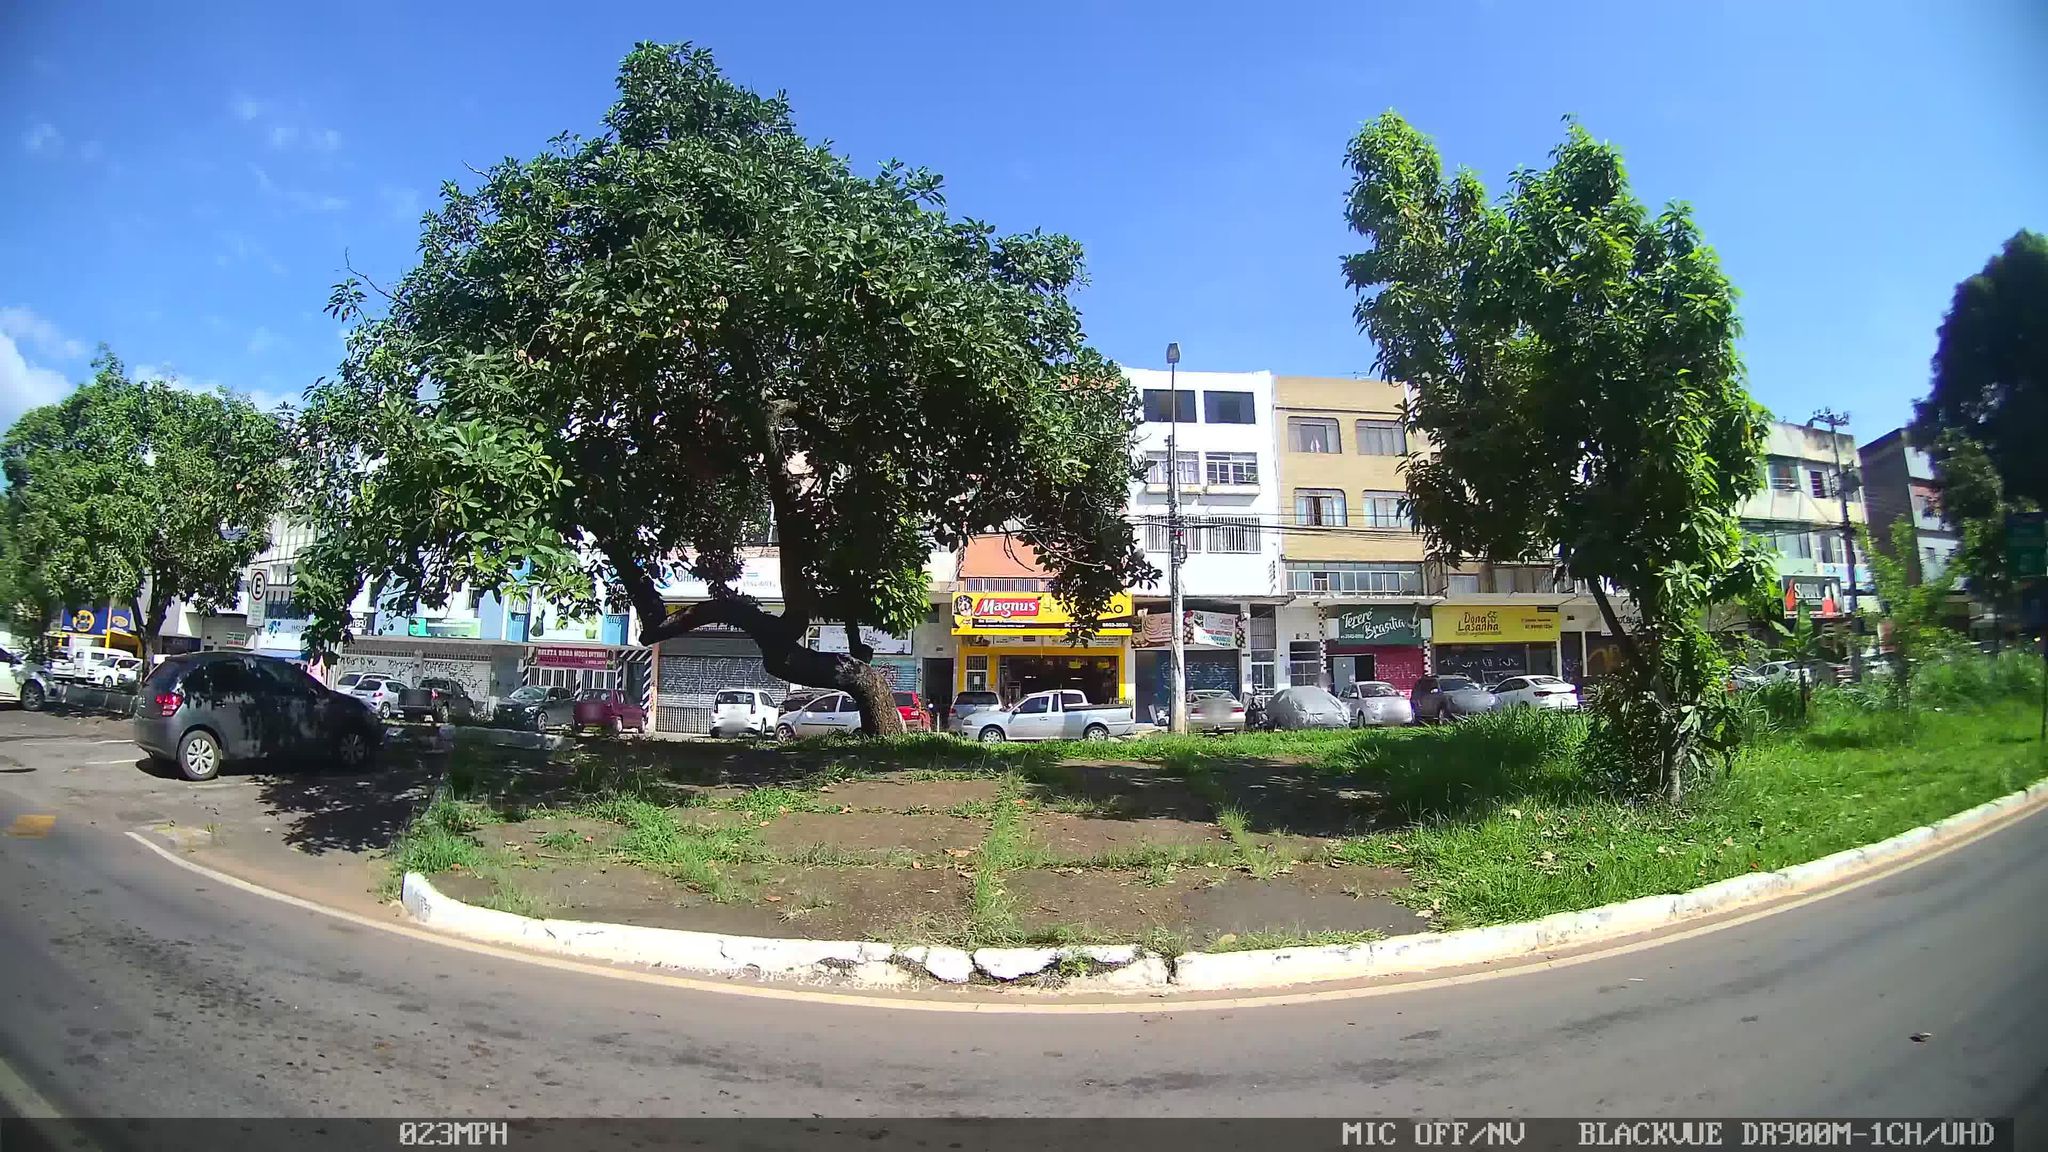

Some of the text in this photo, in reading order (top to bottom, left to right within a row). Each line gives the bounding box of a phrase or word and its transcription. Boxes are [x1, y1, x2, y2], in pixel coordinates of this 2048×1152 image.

[255, 577, 261, 595] E
[975, 599, 1037, 617] Magnus
[1341, 607, 1373, 629] Tereré
[1457, 619, 1499, 632] Lasanha
[1464, 612, 1486, 623] Dona
